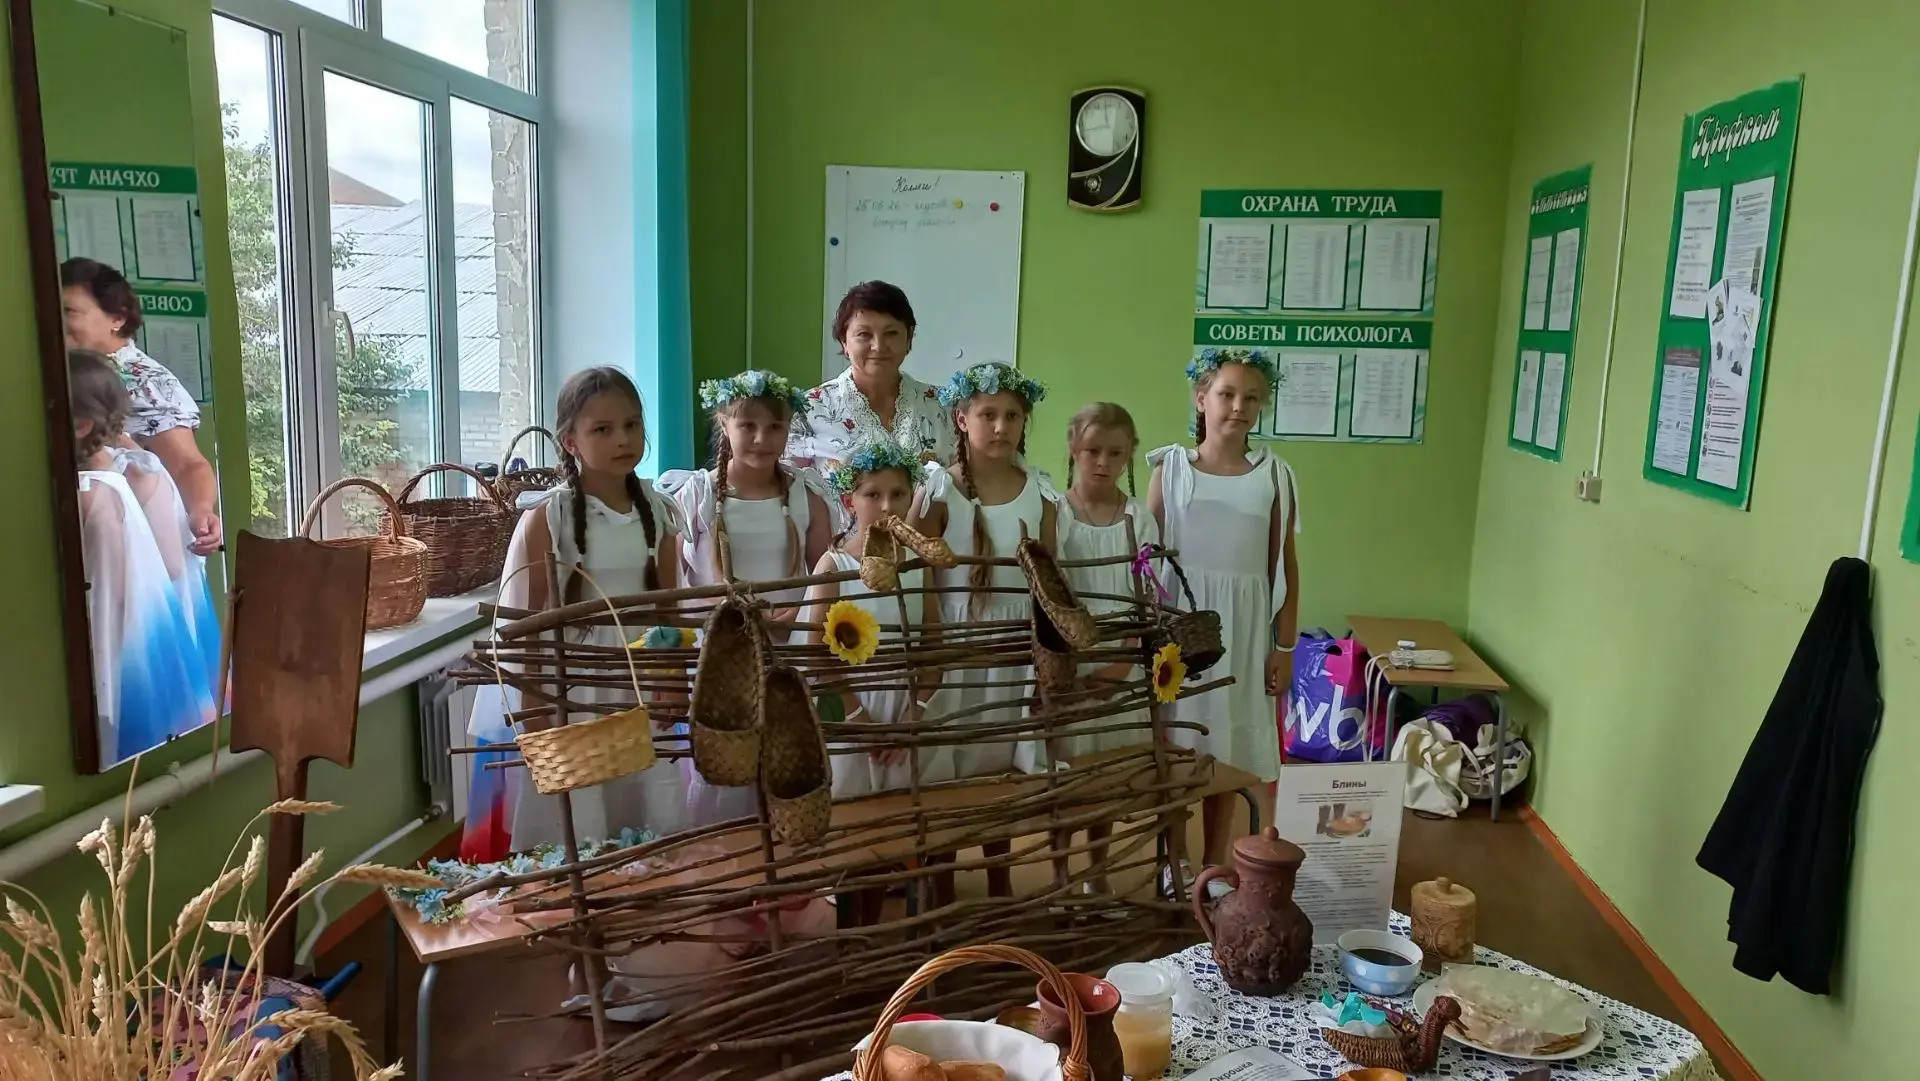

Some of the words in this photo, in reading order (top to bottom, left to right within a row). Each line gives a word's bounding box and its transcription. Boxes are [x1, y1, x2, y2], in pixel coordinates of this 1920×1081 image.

[1691, 107, 1780, 168] Профком
[1241, 196, 1320, 213] ОХРАНА
[1331, 196, 1397, 215] ТРУДА
[1209, 324, 1286, 341] СОВЕТЫ
[1296, 325, 1414, 343] ПСИХОЛОГА
[1285, 684, 1365, 751] wb
[1332, 780, 1367, 789] Блины
[1209, 1061, 1254, 1081] Окрошка
